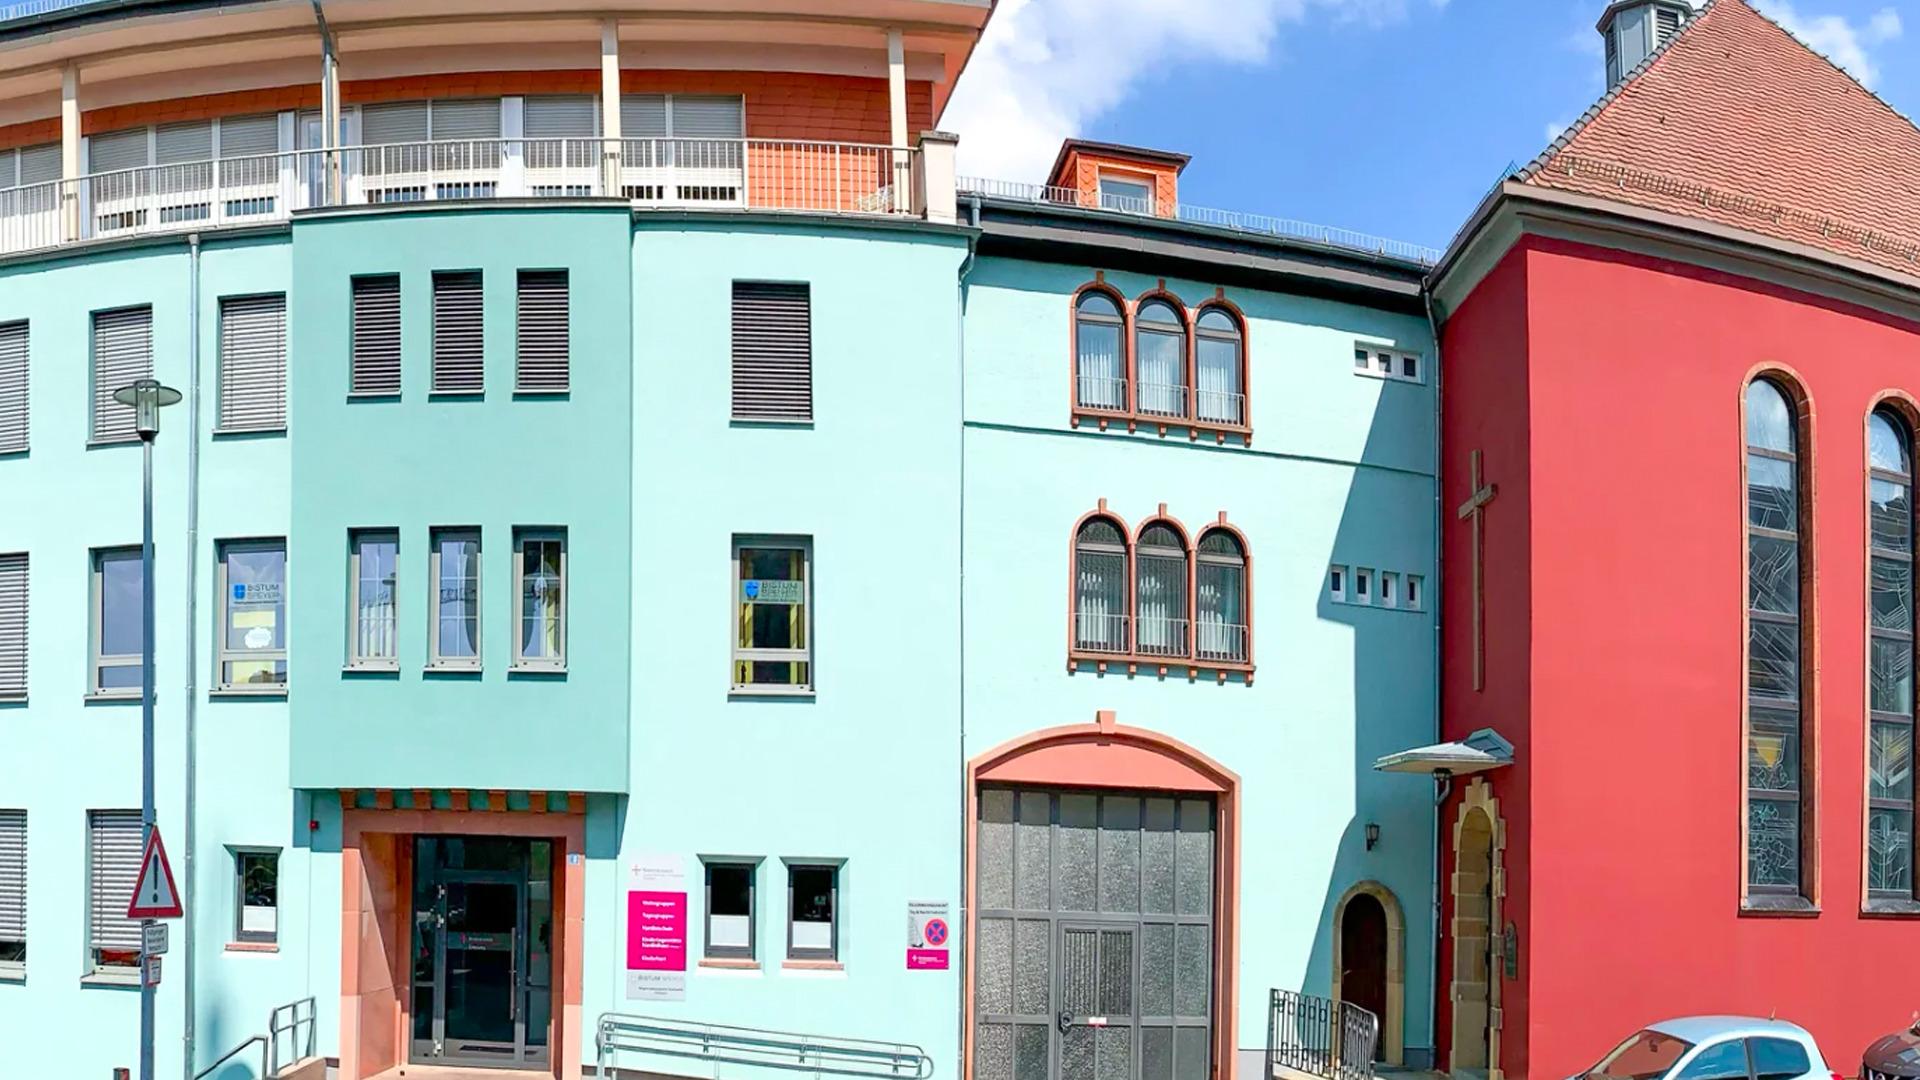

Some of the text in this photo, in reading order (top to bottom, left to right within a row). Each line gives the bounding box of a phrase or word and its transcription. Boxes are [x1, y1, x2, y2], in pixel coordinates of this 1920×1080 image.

[247, 583, 280, 592] BISTUM
[761, 581, 798, 589] BISTUM
[247, 592, 281, 600] SPEYER
